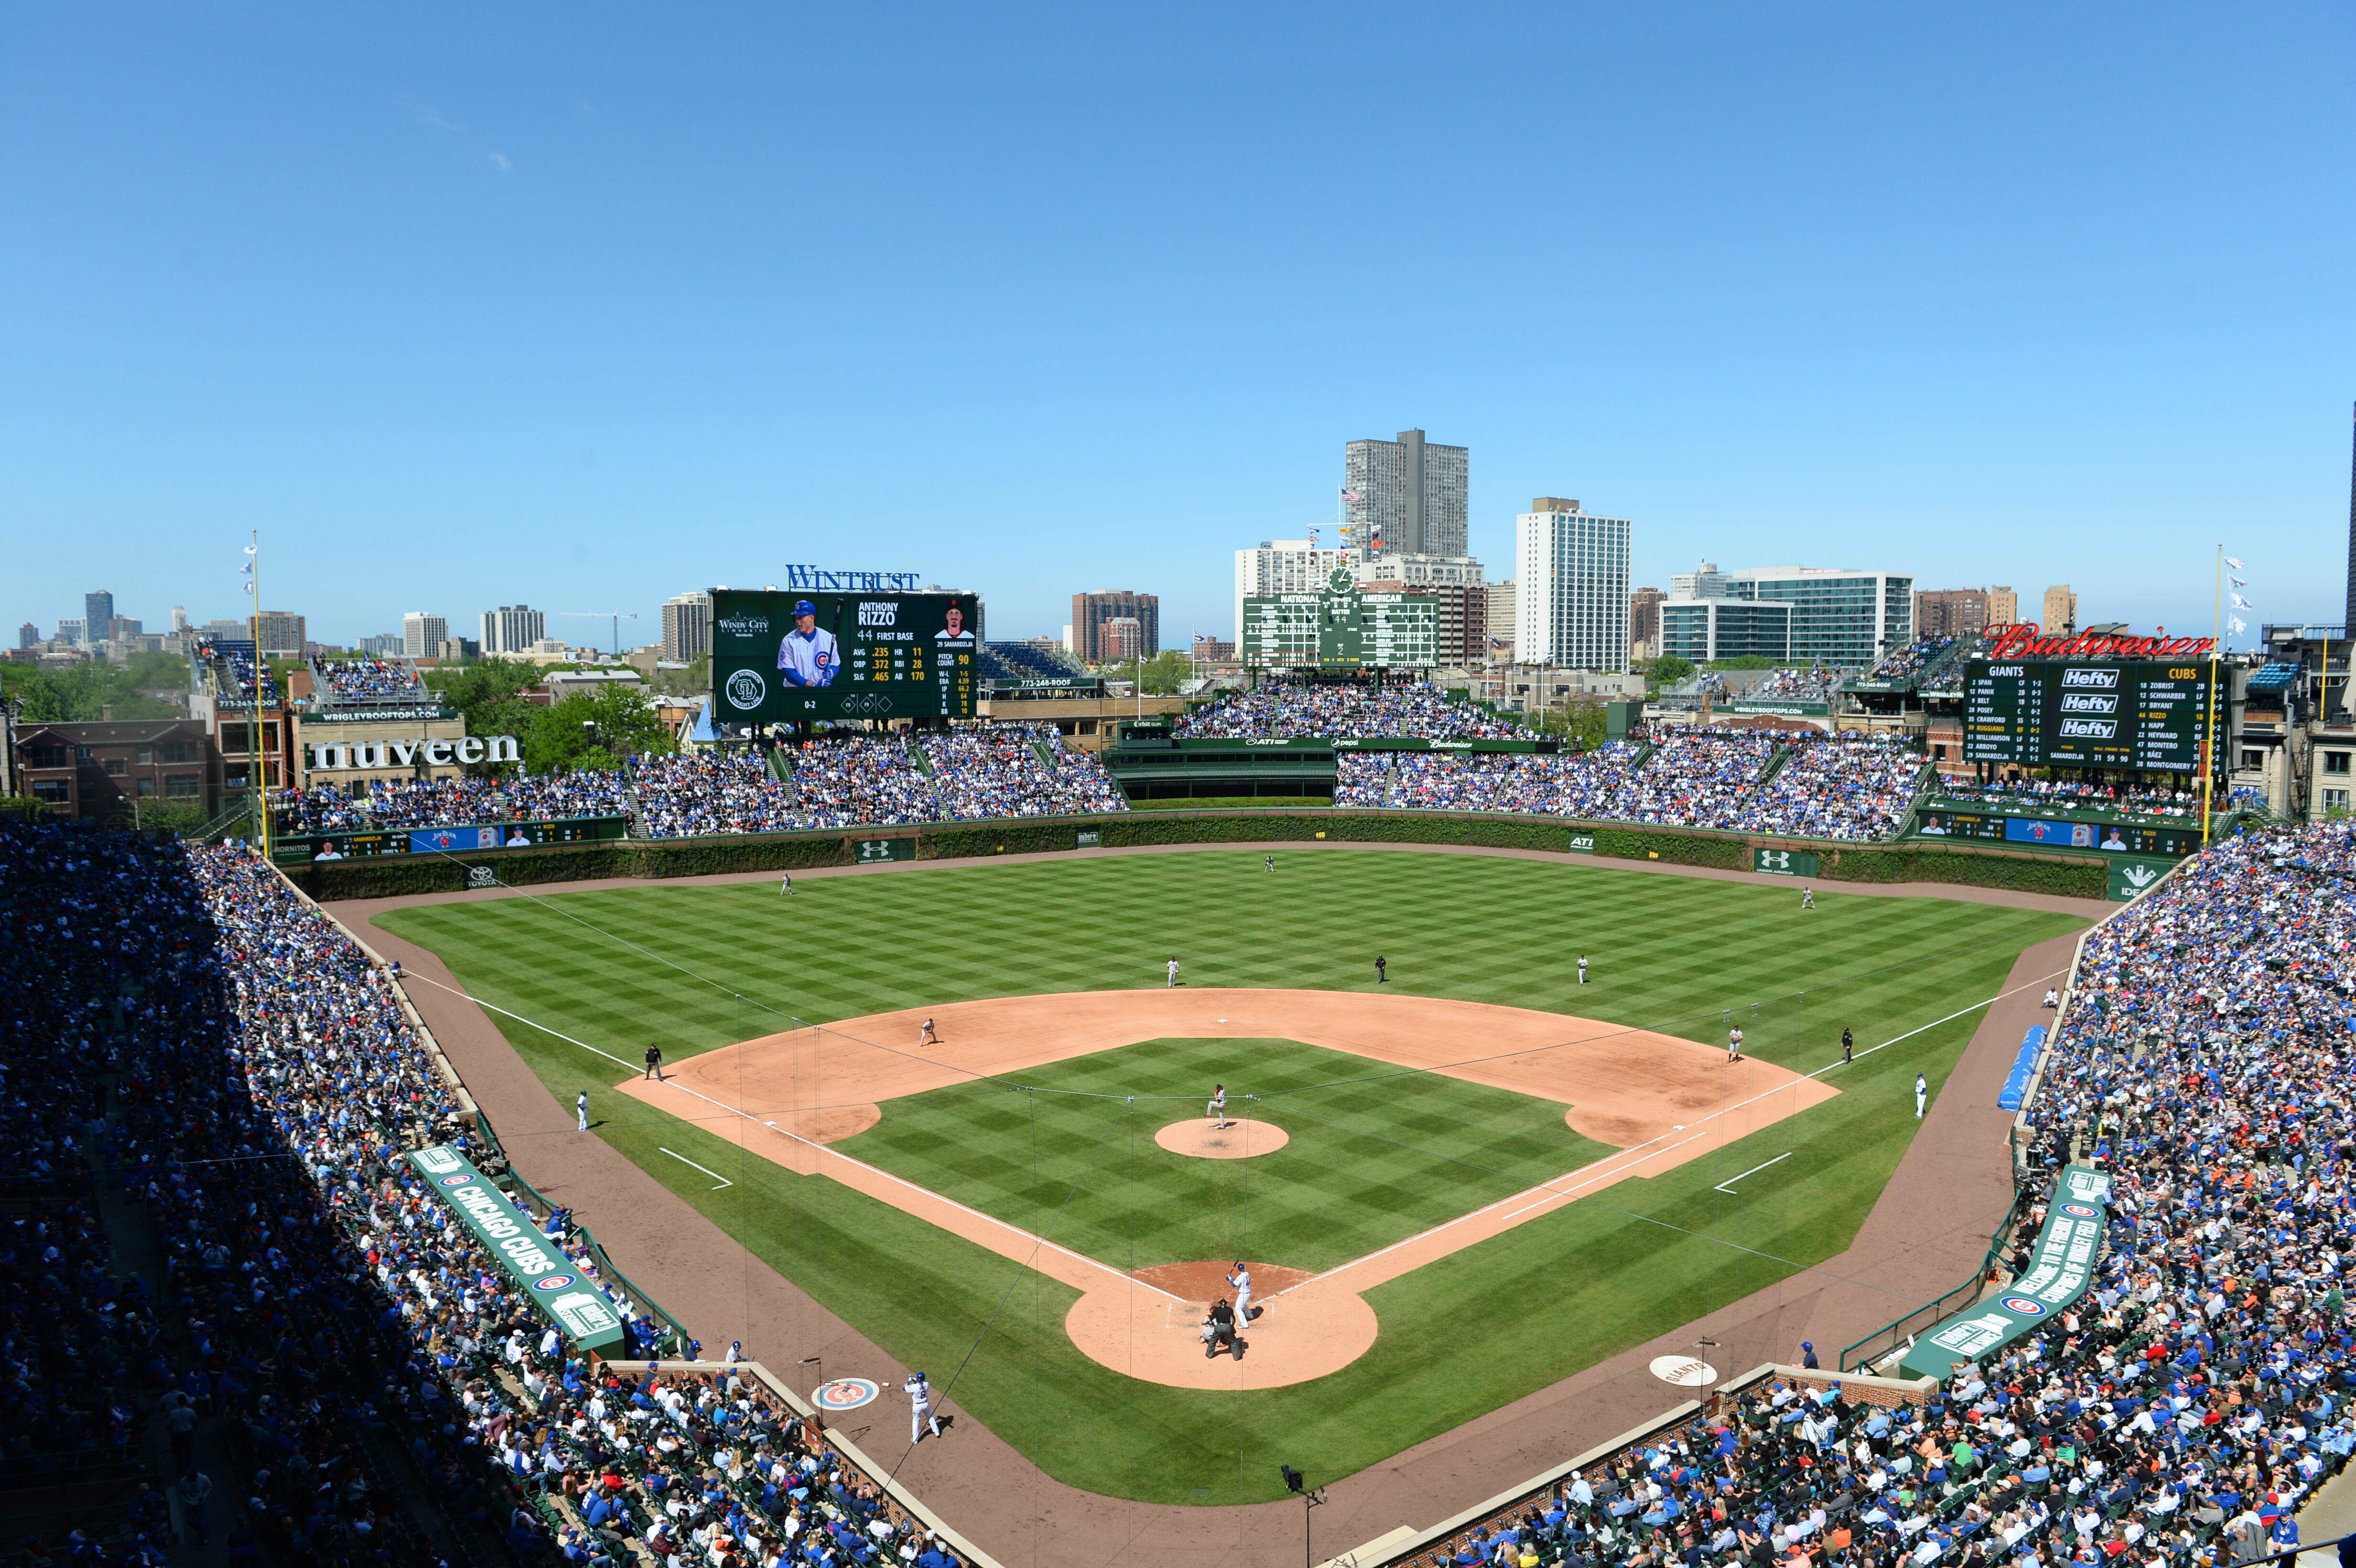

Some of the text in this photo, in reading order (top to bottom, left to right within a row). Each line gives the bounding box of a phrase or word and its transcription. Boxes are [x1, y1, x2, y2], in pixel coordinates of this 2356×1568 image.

[785, 564, 919, 591] WINTRUST
[1281, 595, 1320, 603] NATIONAL
[1361, 594, 1402, 602] AMERICAN
[859, 602, 898, 611] ANTHONY
[858, 611, 895, 626] RIZZO
[1335, 615, 1346, 623] 44
[720, 620, 769, 629] WINDY CITY
[857, 630, 873, 641] 44
[1984, 622, 2220, 659] Budweiser
[872, 647, 889, 656] .235
[913, 647, 922, 656] 11
[872, 660, 889, 669] .372
[913, 659, 922, 669] 28
[958, 654, 969, 664] 90
[873, 672, 889, 681] .465
[911, 672, 925, 681] 170
[1989, 666, 2023, 677] GIANTS
[2169, 668, 2196, 679] CUBS
[730, 672, 761, 684] OLD DOMINION
[1021, 679, 1071, 687] 773-248-ROOF
[2066, 671, 2115, 687] Hefty
[731, 696, 761, 707] FREIGHT LINE
[2065, 696, 2114, 712] Hefty
[323, 711, 440, 721] WRIGLEYROOFTOPS.COM
[1734, 707, 1802, 715] WRIGLEYROOFTOPS.COM
[2063, 721, 2113, 737] Hefty
[1429, 739, 1472, 749] Budweiser
[311, 735, 521, 769] nuveen
[2050, 752, 2084, 760] SAMARDZIJA
[2147, 751, 2162, 759] BÁEZ
[2147, 762, 2191, 770] MONTGOMERY
[2027, 821, 2051, 832] JIM BEAM
[432, 830, 457, 841] JIM BEAM
[1078, 833, 1092, 841] weber
[1571, 837, 1594, 846] ATI
[274, 844, 310, 853] HORNITOS
[452, 1186, 556, 1275] CHICAGO CUBS
[2012, 1216, 2074, 1295] WELCOME TO THE FRIENDLY
[2038, 1220, 2098, 1303] CONFINES OF WRIGLEY FIELD
[578, 1304, 609, 1323] weber
[560, 1309, 589, 1335] SEASONINGS
[1939, 1327, 1972, 1345] weber
[1666, 1361, 1707, 1383] GIANTS
[920, 1391, 926, 1399] 8
